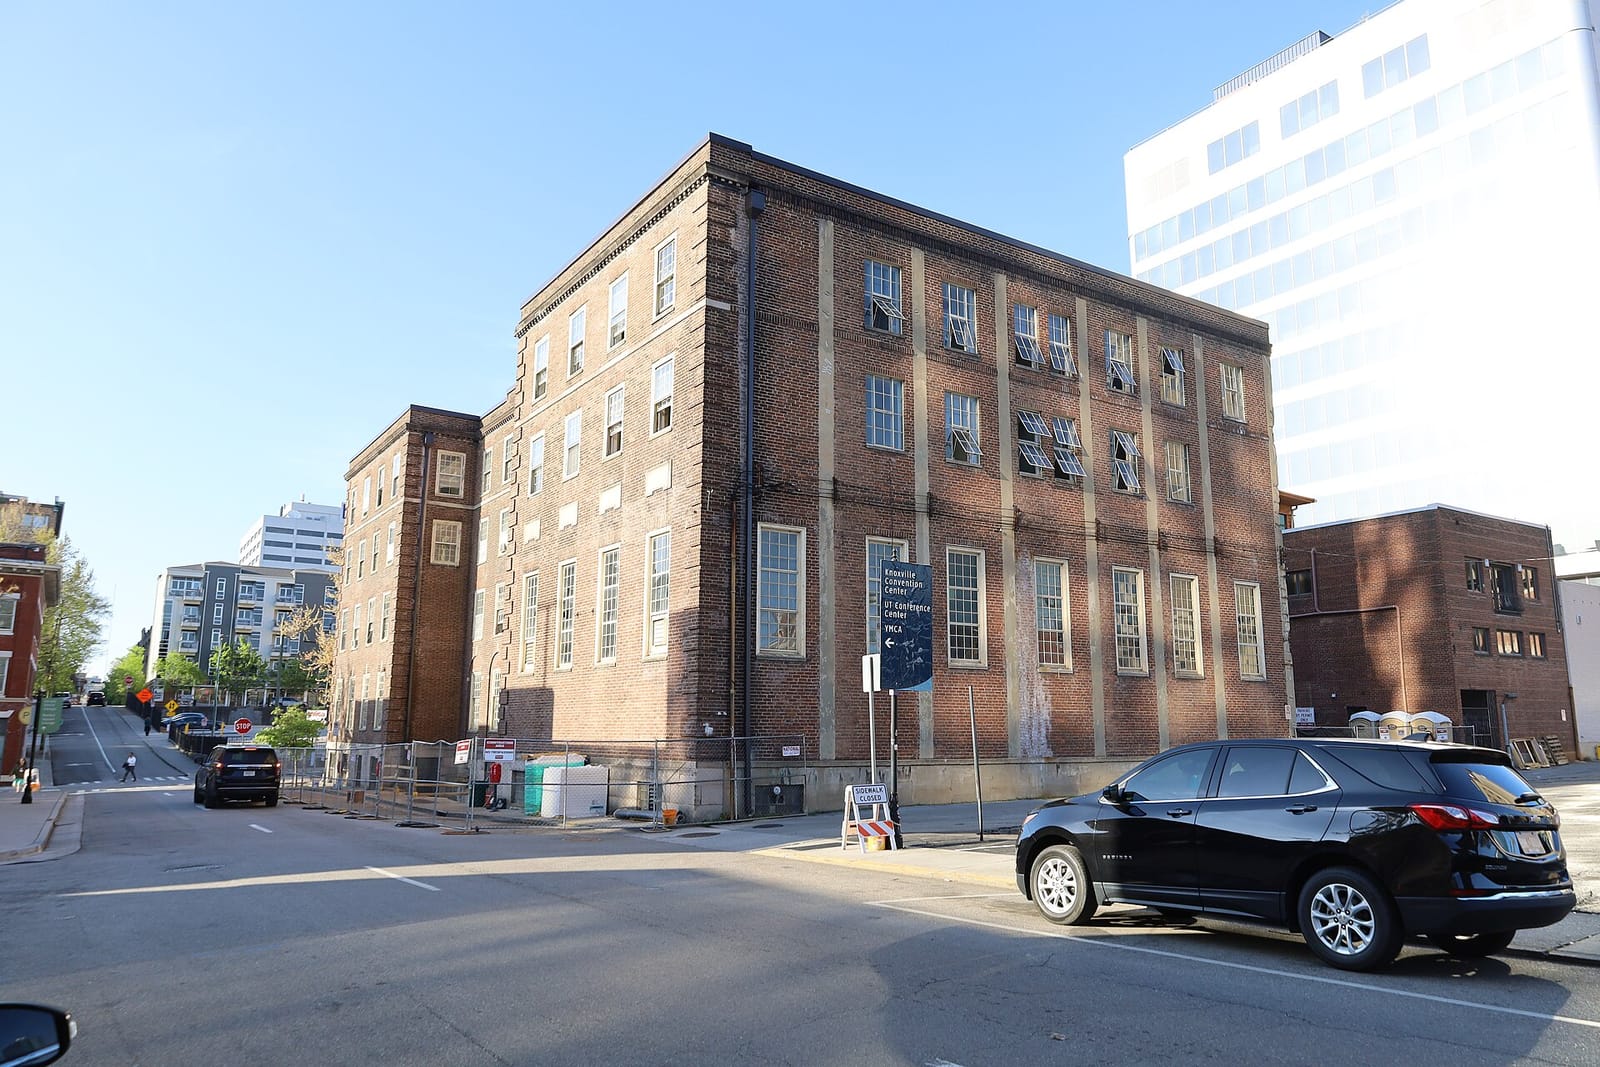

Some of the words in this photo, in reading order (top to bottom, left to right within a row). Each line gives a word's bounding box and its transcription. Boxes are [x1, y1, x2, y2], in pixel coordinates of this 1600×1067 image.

[884, 568, 916, 579] Knoxville
[884, 577, 923, 588] Convention
[884, 586, 907, 595] Center
[884, 600, 892, 608] UT
[894, 601, 931, 612] Conference
[884, 609, 907, 619] Center
[884, 625, 903, 633] YMCA
